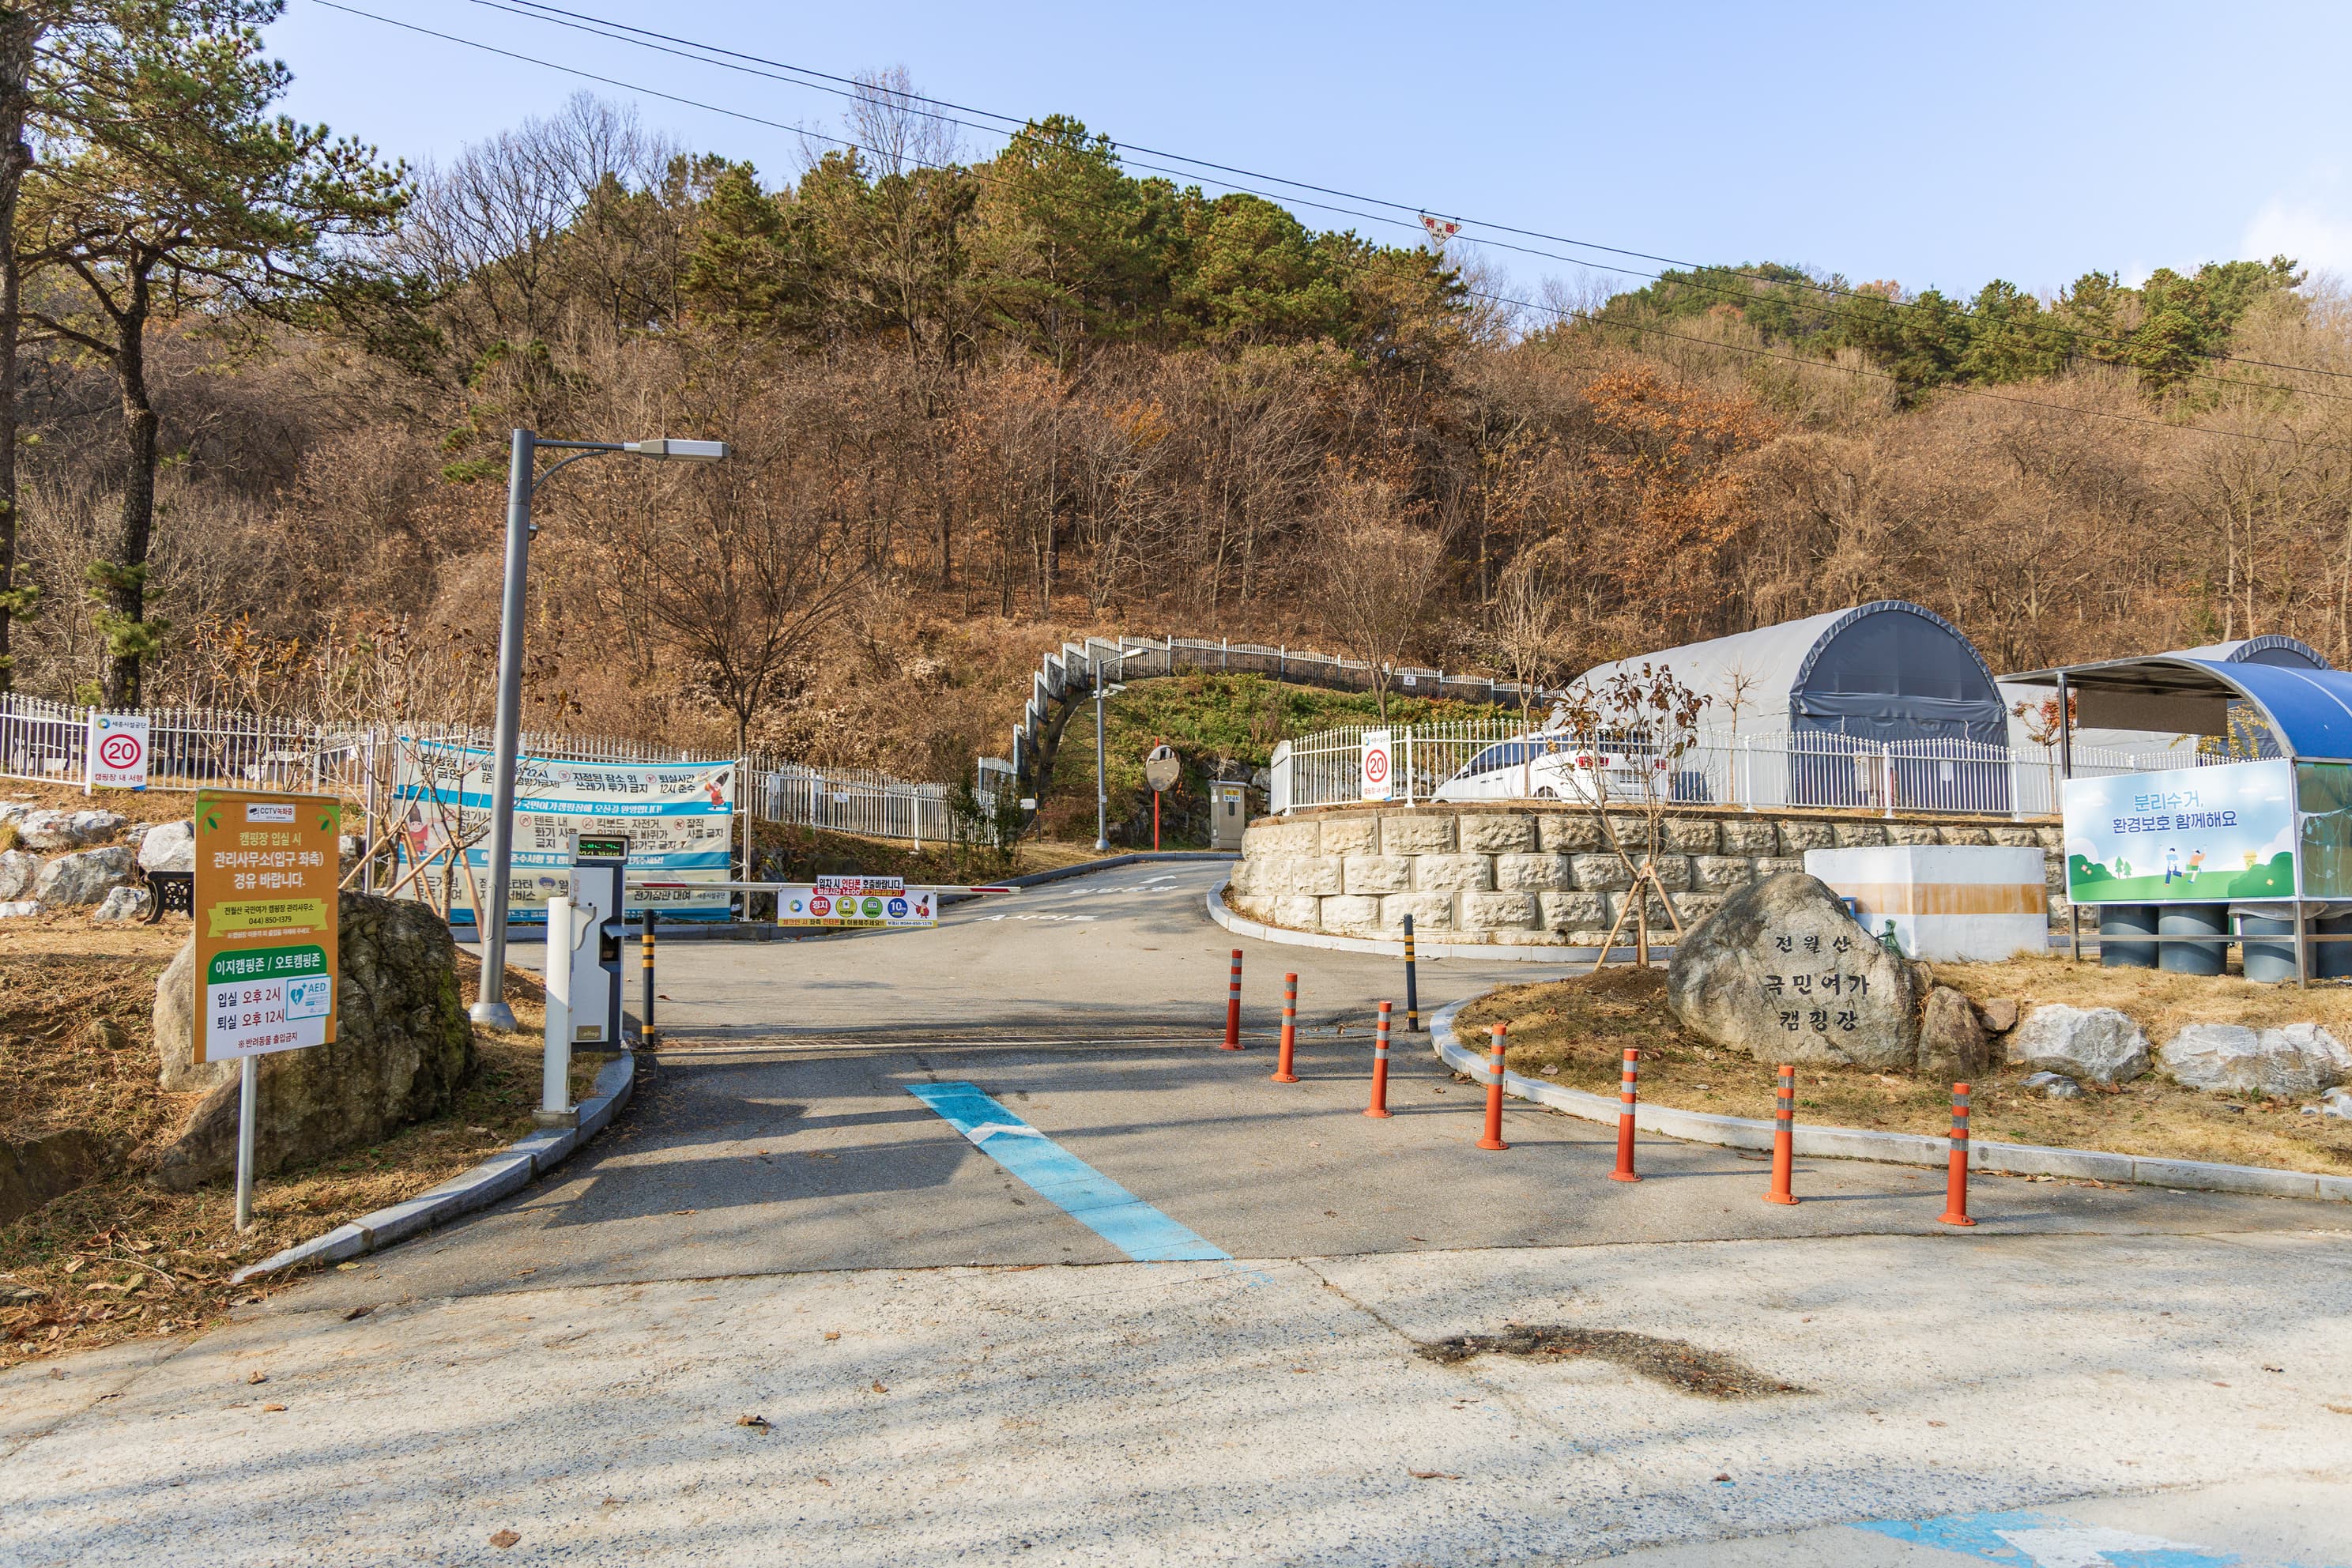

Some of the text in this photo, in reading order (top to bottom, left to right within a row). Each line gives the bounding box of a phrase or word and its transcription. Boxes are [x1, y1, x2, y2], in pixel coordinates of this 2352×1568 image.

[108, 743, 134, 760] 20
[1370, 757, 1384, 774] 20
[573, 772, 603, 782] 지정된
[605, 772, 624, 783] 장소
[659, 774, 695, 784] 퇴실시간
[576, 782, 648, 793] 쓰레기 투기 금지
[660, 784, 695, 793] 12시 준수
[2134, 790, 2203, 812] 분리수거,
[534, 815, 567, 827] 텐트 내
[2113, 810, 2237, 835] 환경보호 함께해요
[535, 827, 556, 838] 화기
[640, 830, 668, 839] 바퀴가
[707, 828, 724, 838] 금지
[240, 832, 301, 846] 캠핑장 입실 시
[535, 839, 556, 848] 금지
[659, 840, 677, 850] 금지
[213, 851, 324, 868] 관리사무소(입구 좌측)
[234, 872, 306, 889] 경유 바랍니다.
[834, 879, 840, 888] 시
[842, 879, 860, 889] 인터폰
[634, 890, 691, 901] 전기장판 대여
[224, 906, 242, 915] 전월산
[244, 906, 267, 914] 국민여가
[269, 904, 285, 914] 캠핑장
[812, 900, 827, 909] 정지
[1776, 935, 1852, 954] 전월산
[216, 957, 265, 975] 이지캠핑존
[275, 953, 321, 969] 오토캠핑존
[308, 982, 326, 993] AED
[1764, 973, 1870, 997] 국민여가
[217, 987, 281, 1008] 입실 오후 2시
[217, 1008, 285, 1031] 퇴실 오후 12시
[1779, 1010, 1860, 1032] 캠핑장
[246, 1035, 271, 1048] 반려동물
[273, 1031, 298, 1044] 출입금지
